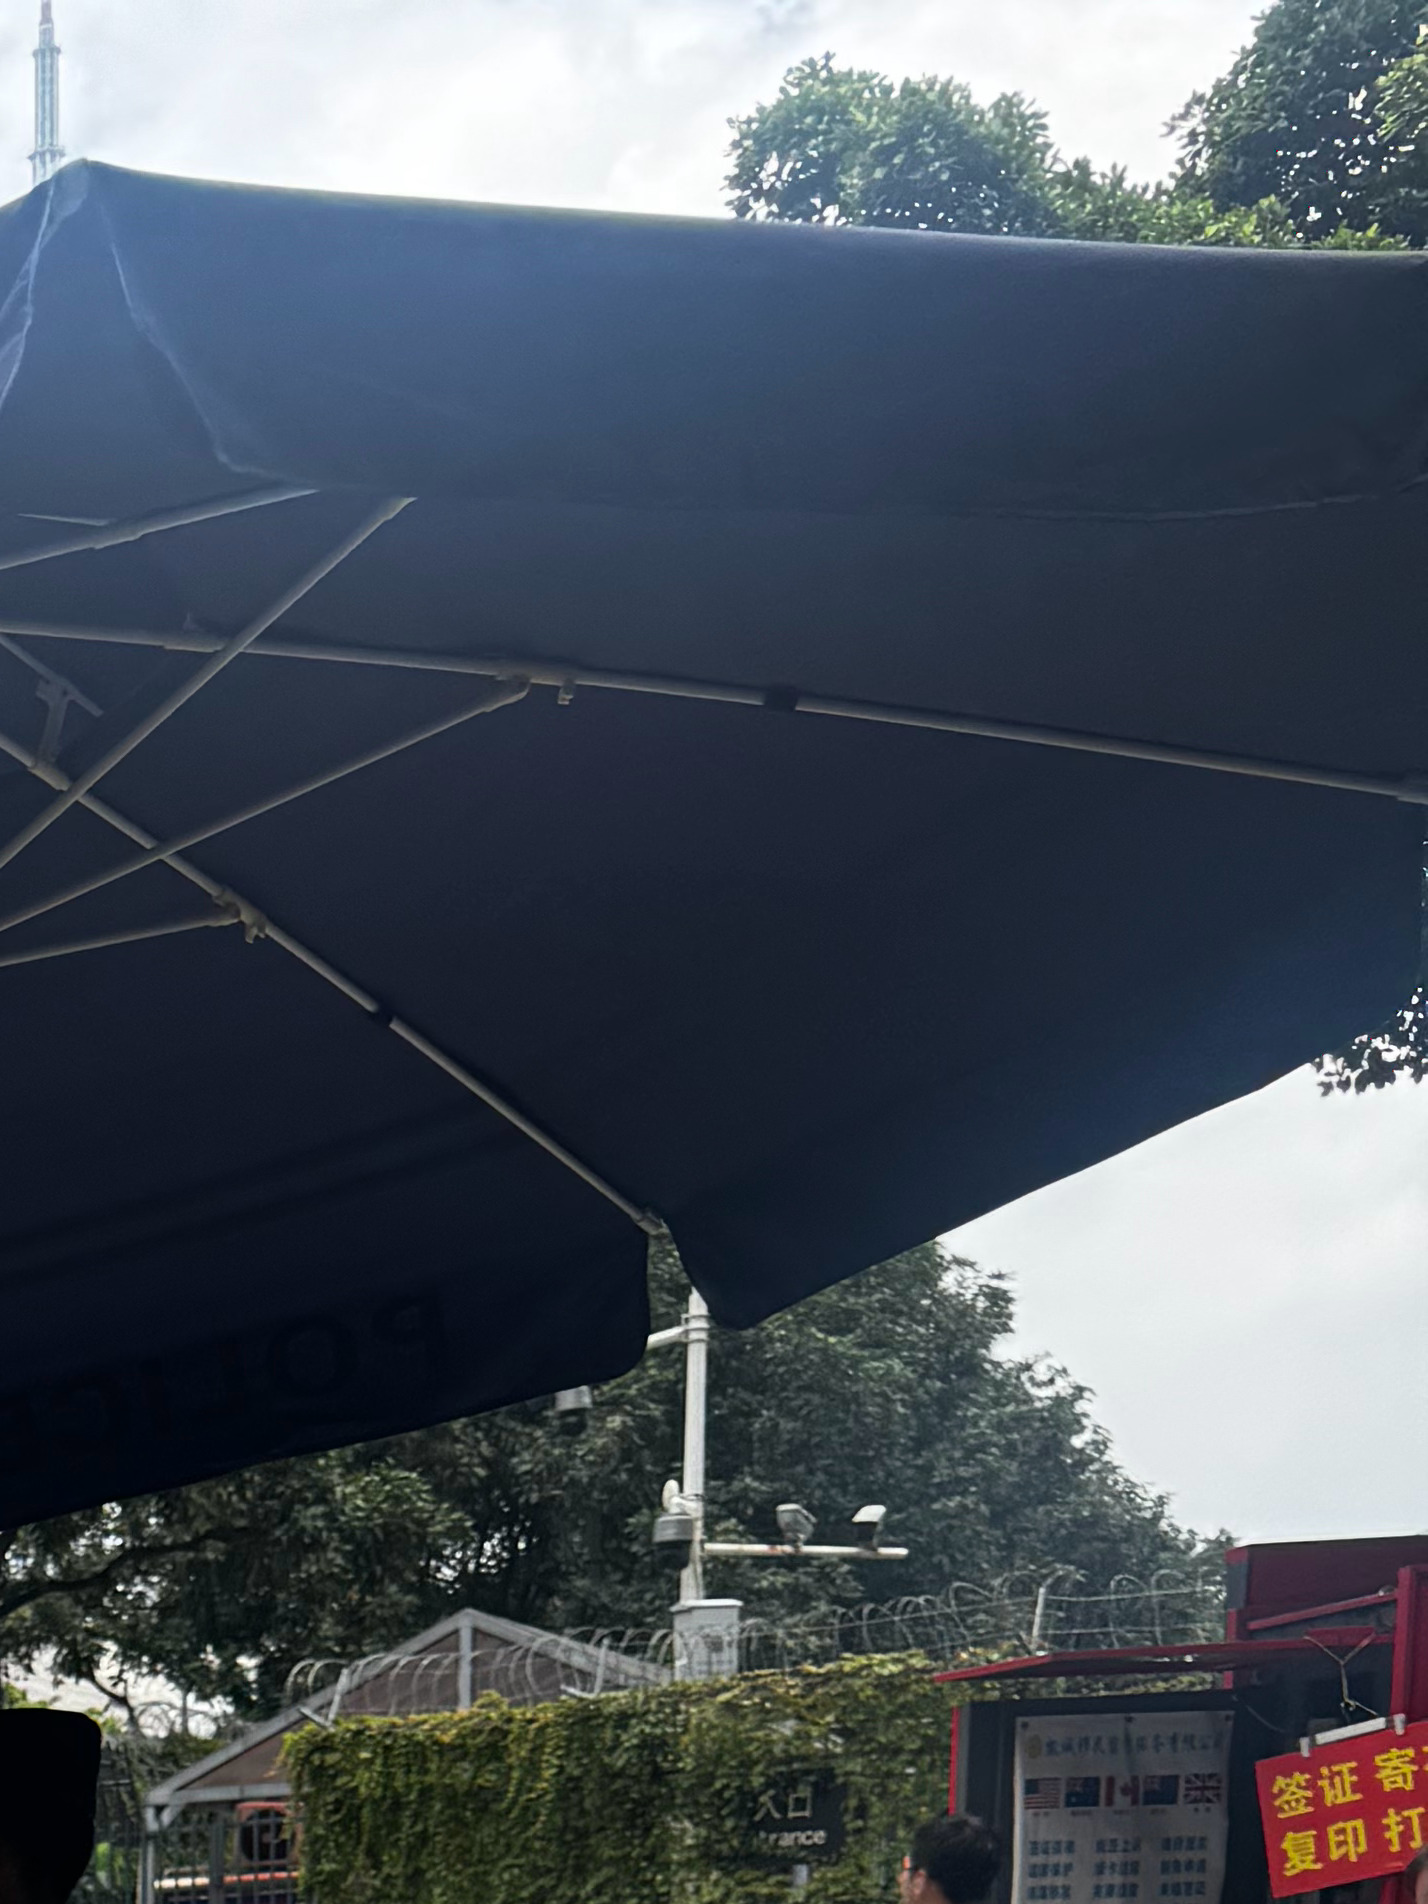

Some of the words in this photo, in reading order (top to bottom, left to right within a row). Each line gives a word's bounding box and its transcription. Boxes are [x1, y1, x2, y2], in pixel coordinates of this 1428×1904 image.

[754, 1788, 812, 1822] 入口
[1272, 1762, 1363, 1818] 签证
[1280, 1818, 1368, 1876] 复印
